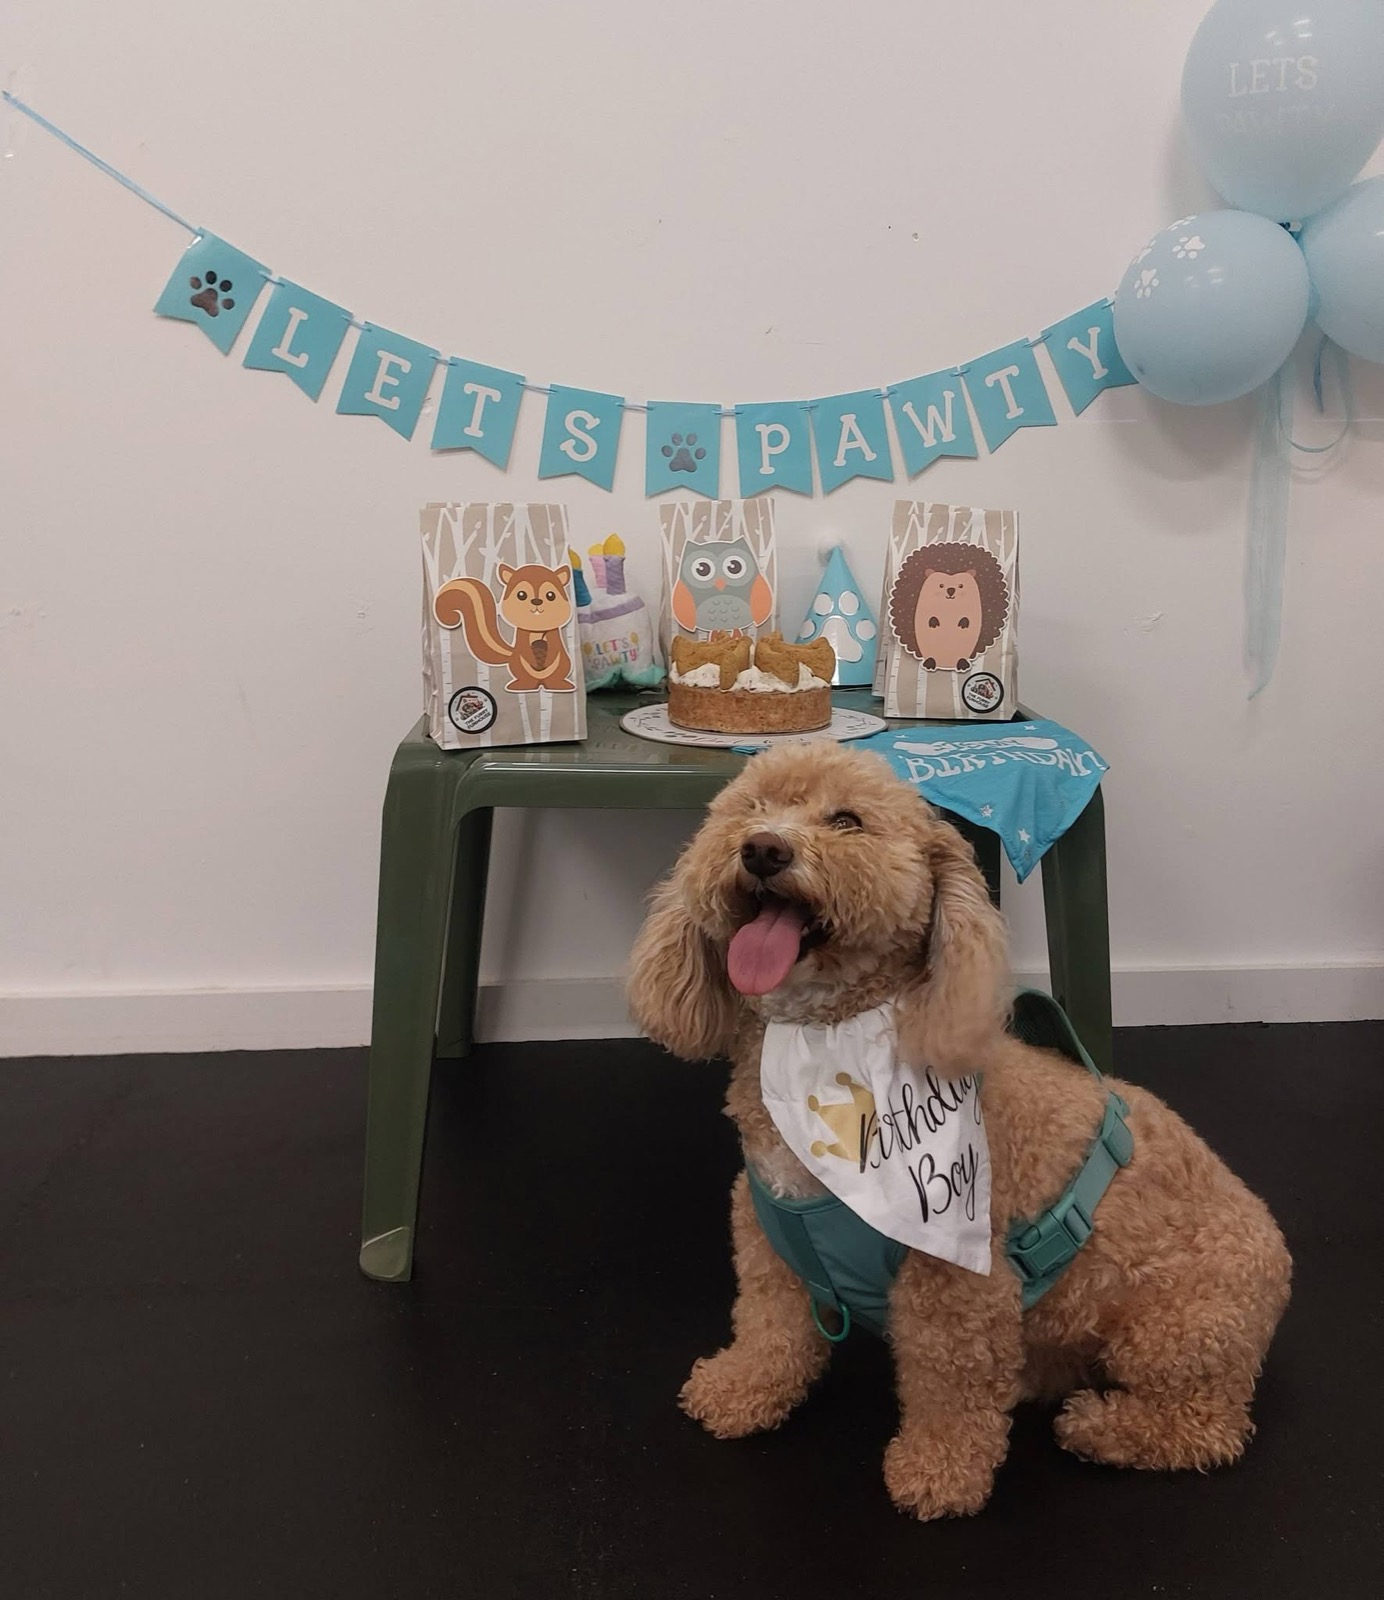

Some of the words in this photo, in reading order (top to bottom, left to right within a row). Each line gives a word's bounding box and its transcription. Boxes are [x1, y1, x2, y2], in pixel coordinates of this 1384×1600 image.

[1227, 55, 1319, 98] LETS
[271, 306, 601, 462] LETS
[755, 326, 1109, 475] PAWTY
[465, 717, 474, 725] THE
[908, 1143, 979, 1223] Boy
